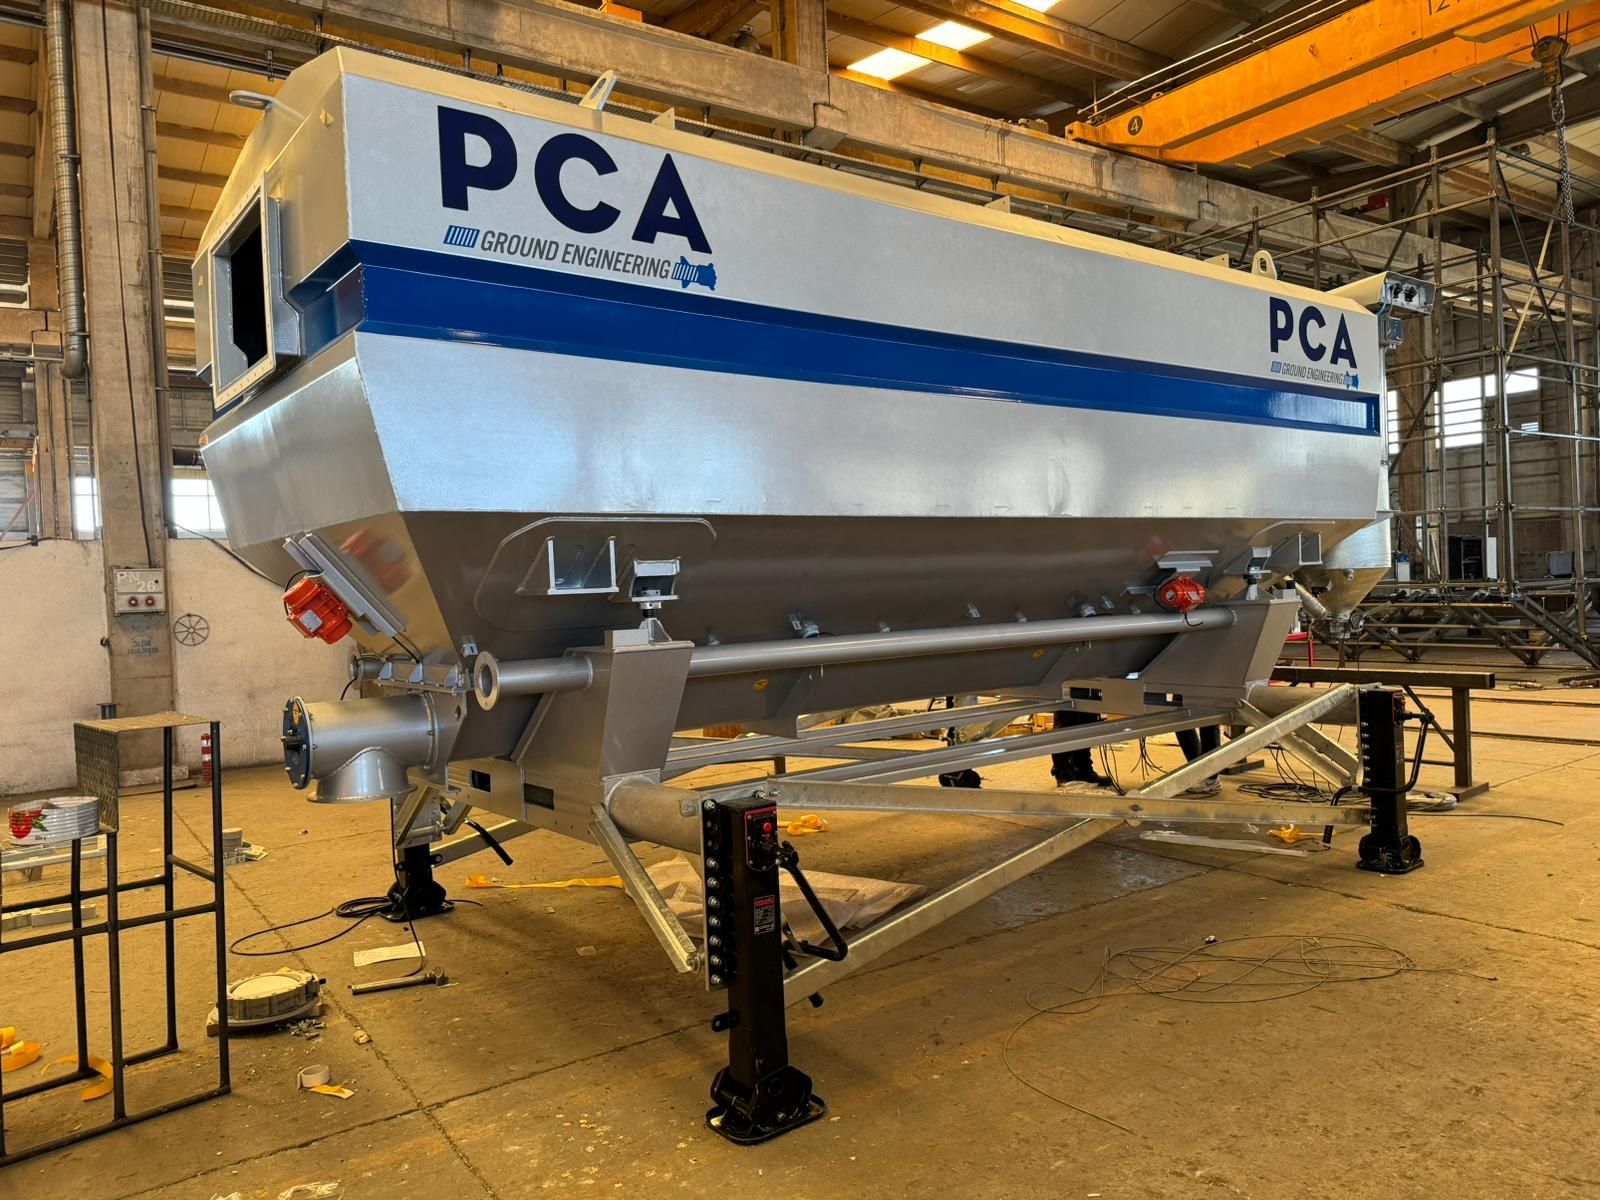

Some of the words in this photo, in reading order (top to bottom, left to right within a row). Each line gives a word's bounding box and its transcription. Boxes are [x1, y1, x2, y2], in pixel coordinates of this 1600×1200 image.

[437, 105, 713, 255] PCA
[480, 230, 559, 261] GROUND
[561, 243, 671, 279] ENGINEERING
[1269, 296, 1358, 369] PCA
[1281, 362, 1307, 378] GROUND
[1307, 367, 1344, 385] ENGINEERING
[137, 580, 156, 592] 26
